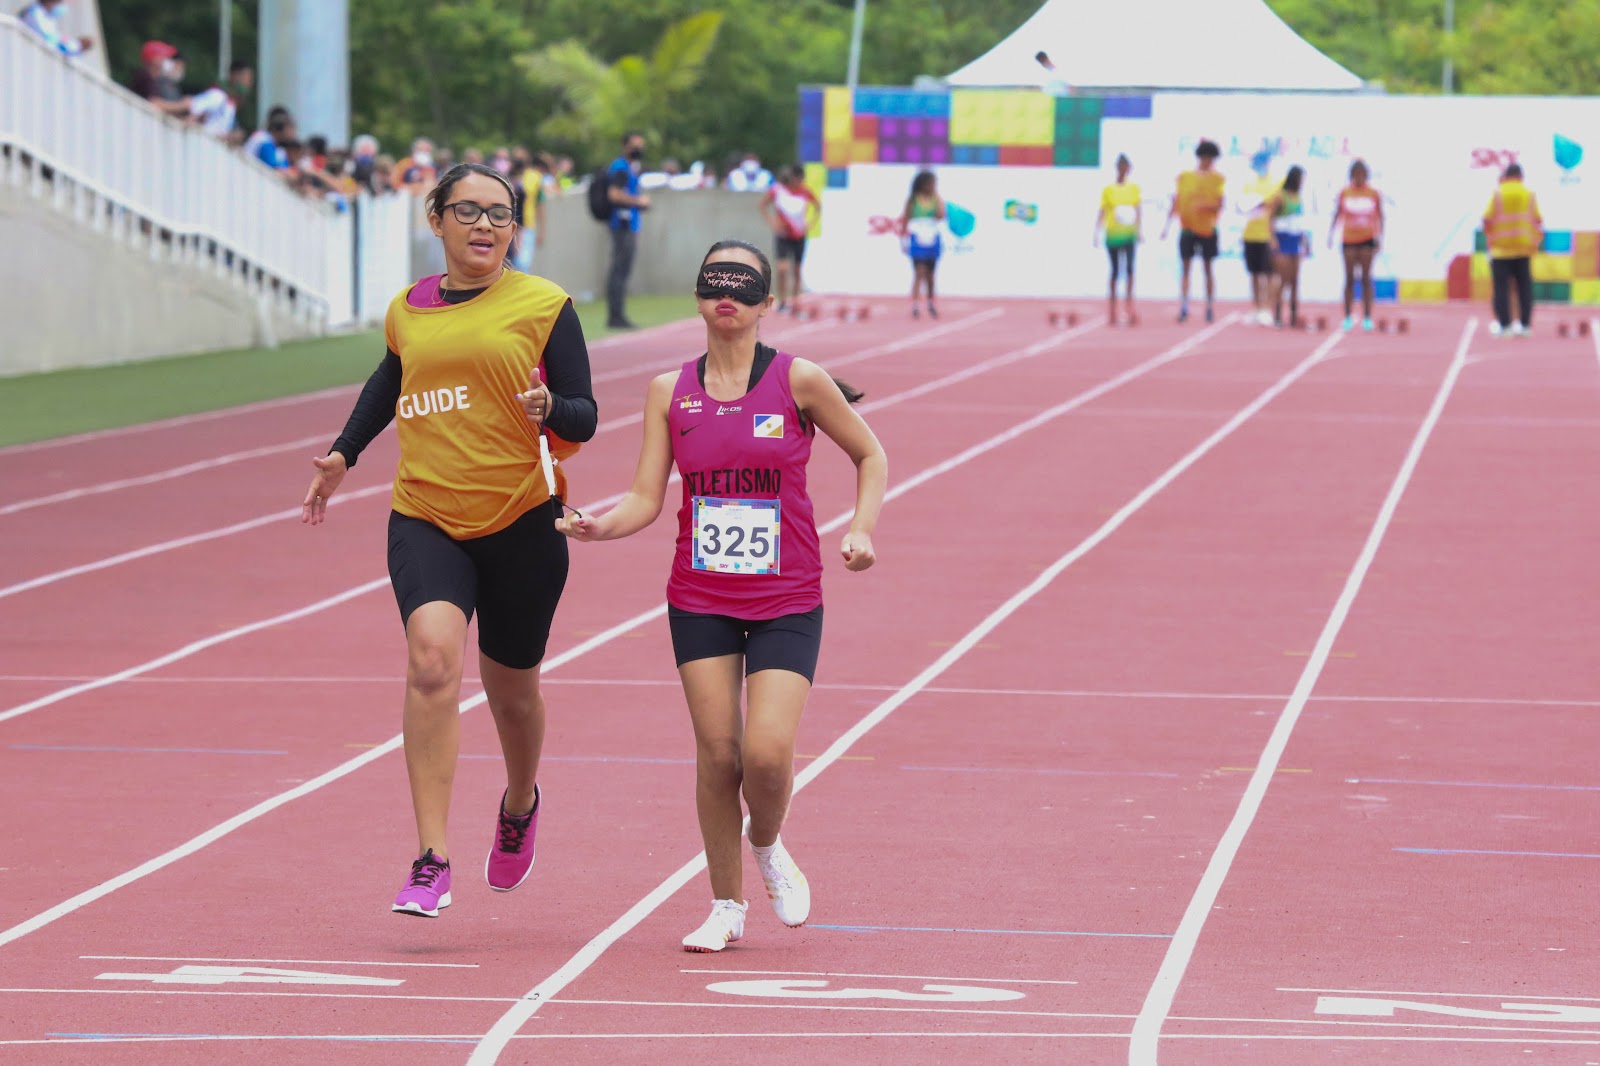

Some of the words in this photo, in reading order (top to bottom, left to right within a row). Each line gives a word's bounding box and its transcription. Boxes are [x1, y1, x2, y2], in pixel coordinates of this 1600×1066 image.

[399, 385, 471, 419] GUIDE
[680, 400, 702, 409] BOLSA
[702, 523, 770, 559] 325
